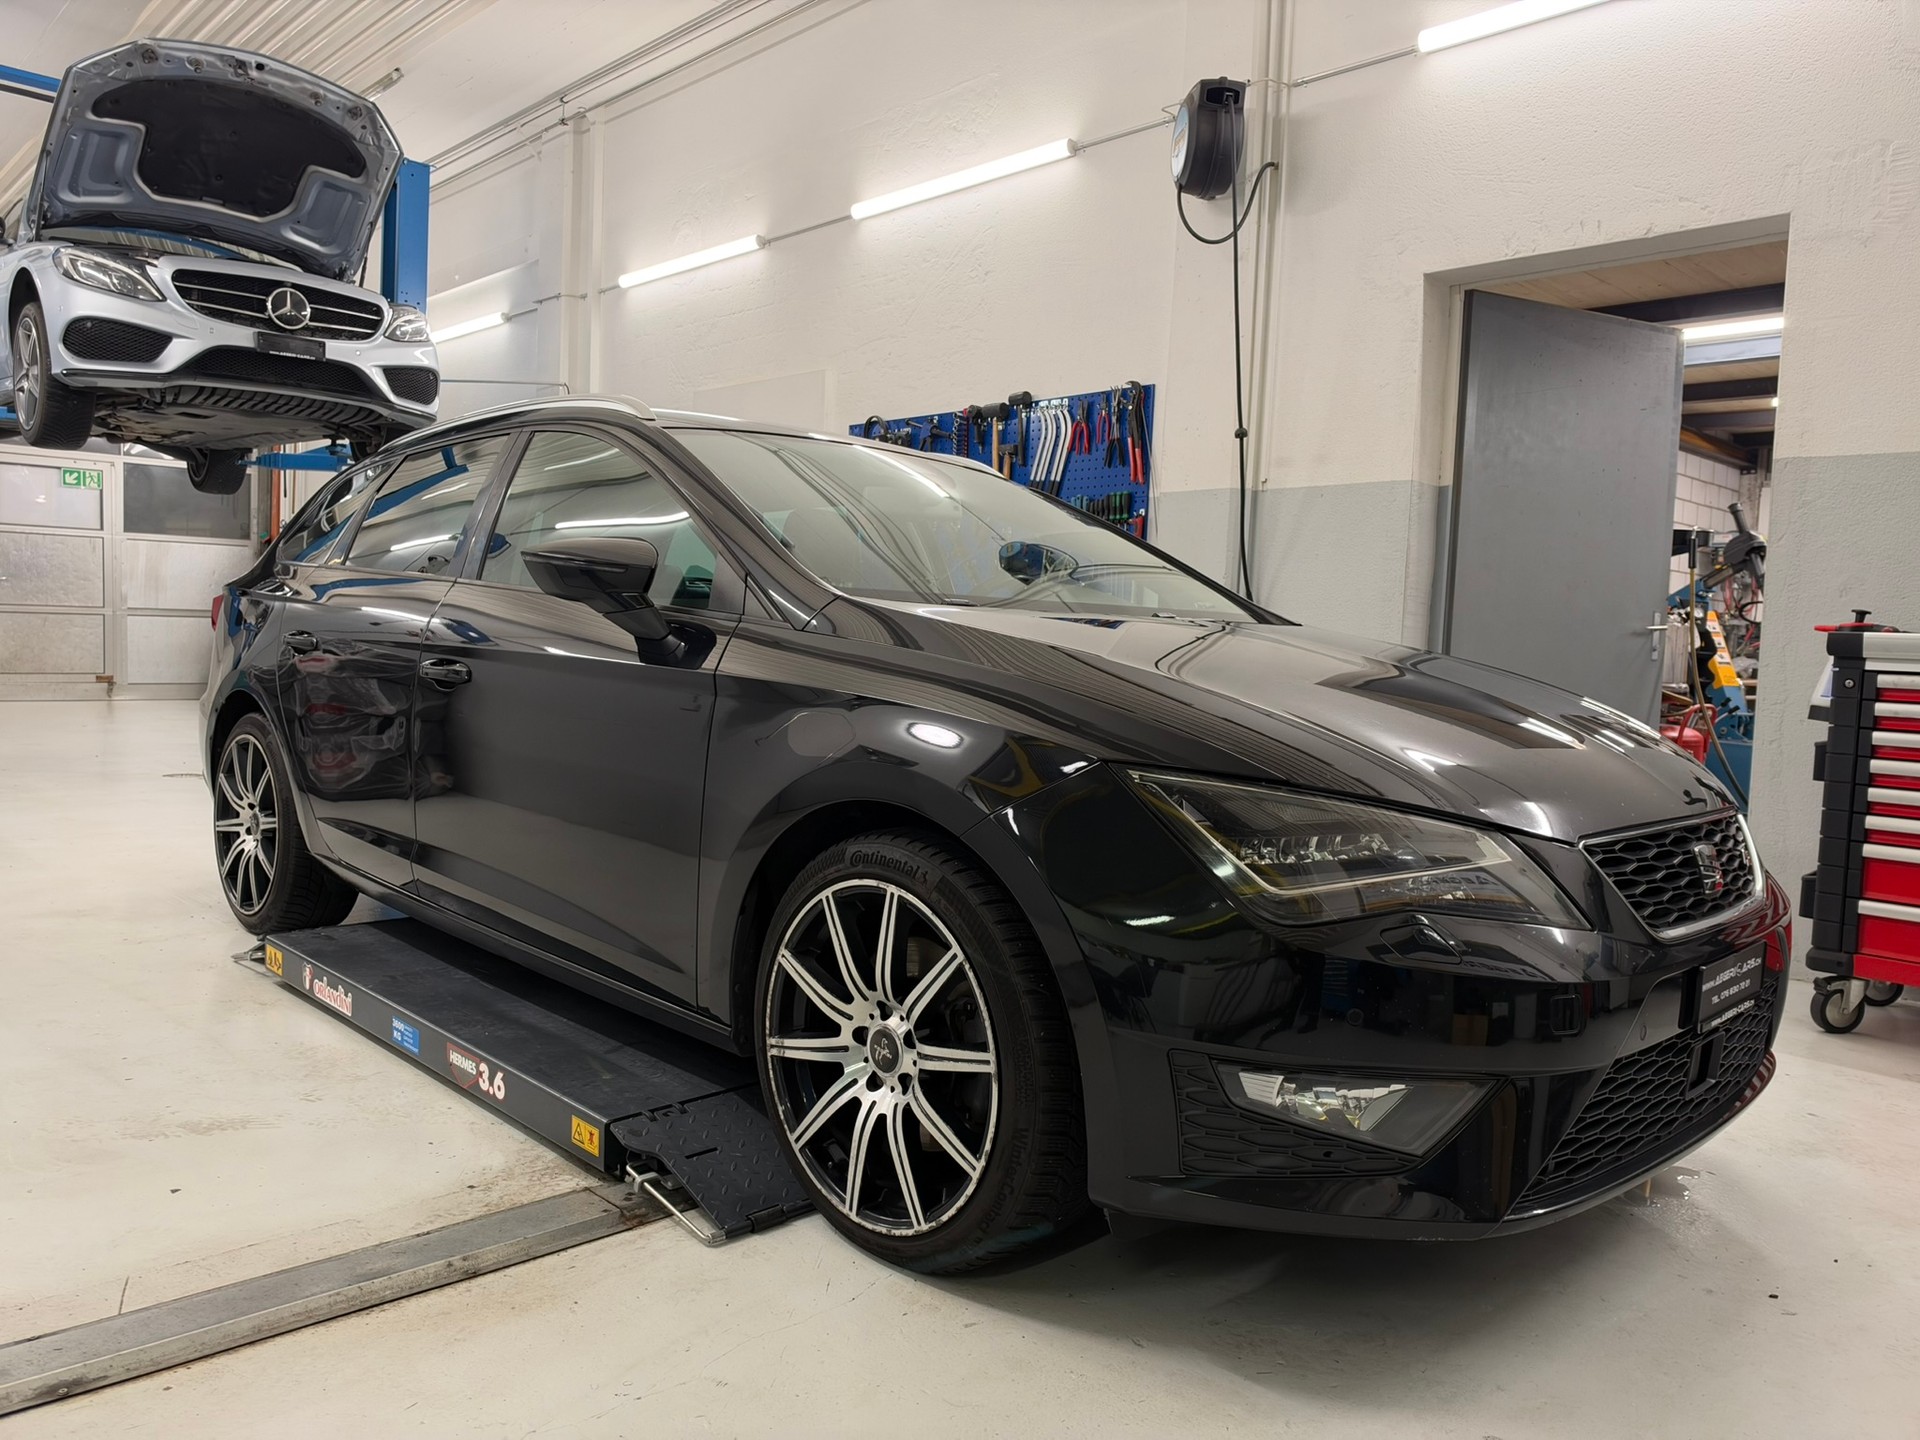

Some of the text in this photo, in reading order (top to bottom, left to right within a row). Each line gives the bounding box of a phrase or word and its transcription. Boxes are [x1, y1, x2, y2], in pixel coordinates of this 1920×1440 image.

[850, 850, 920, 880] Continental
[450, 1049, 506, 1100] HERMES 3.6
